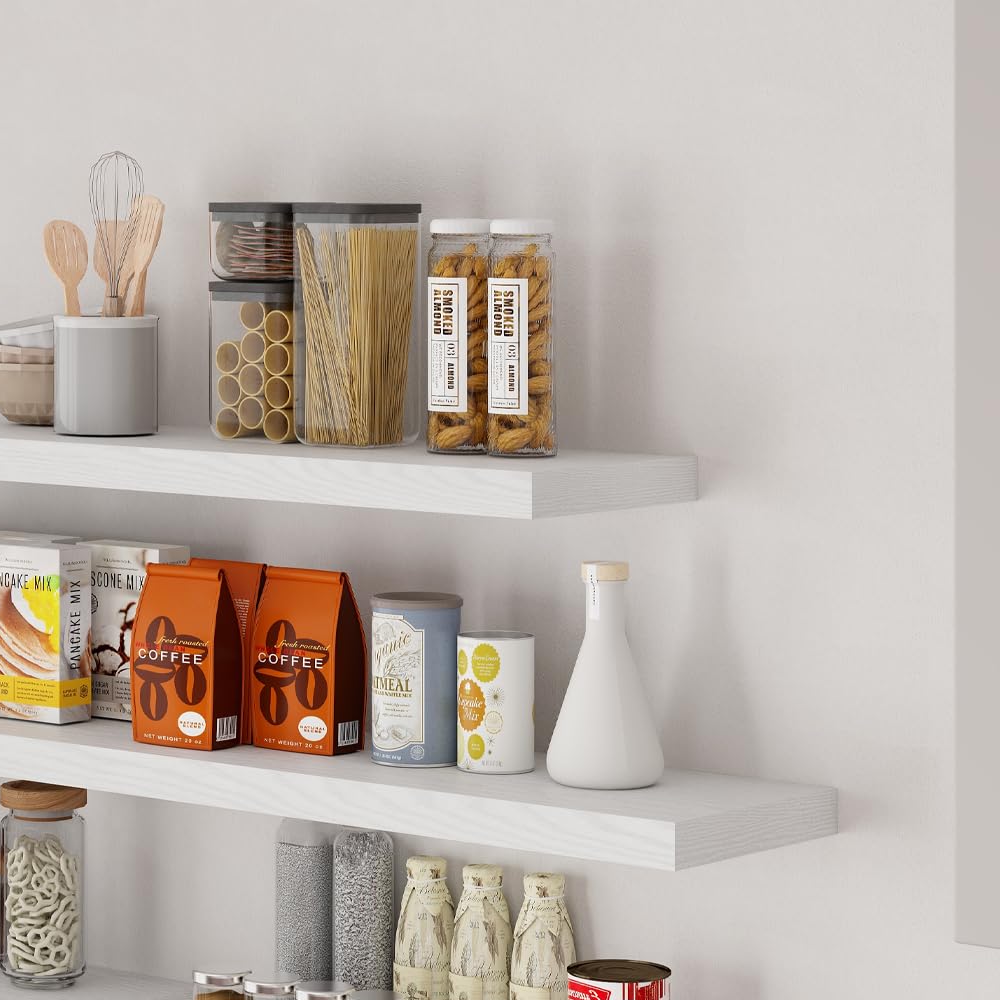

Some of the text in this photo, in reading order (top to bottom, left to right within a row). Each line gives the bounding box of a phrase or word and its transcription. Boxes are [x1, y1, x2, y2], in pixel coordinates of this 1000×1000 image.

[442, 290, 453, 335] SMOKED
[494, 290, 502, 336] ALMOND
[503, 290, 513, 337] SMOKED
[447, 343, 456, 357] 03
[508, 345, 516, 358] 03
[34, 575, 51, 592] MIX
[91, 571, 144, 590] SCONE MIX
[70, 580, 80, 670] PANCAKE MIX
[154, 635, 177, 644] fresh
[274, 639, 298, 648] fresh
[138, 648, 203, 665] COFFEE
[258, 652, 323, 669] COFFEE
